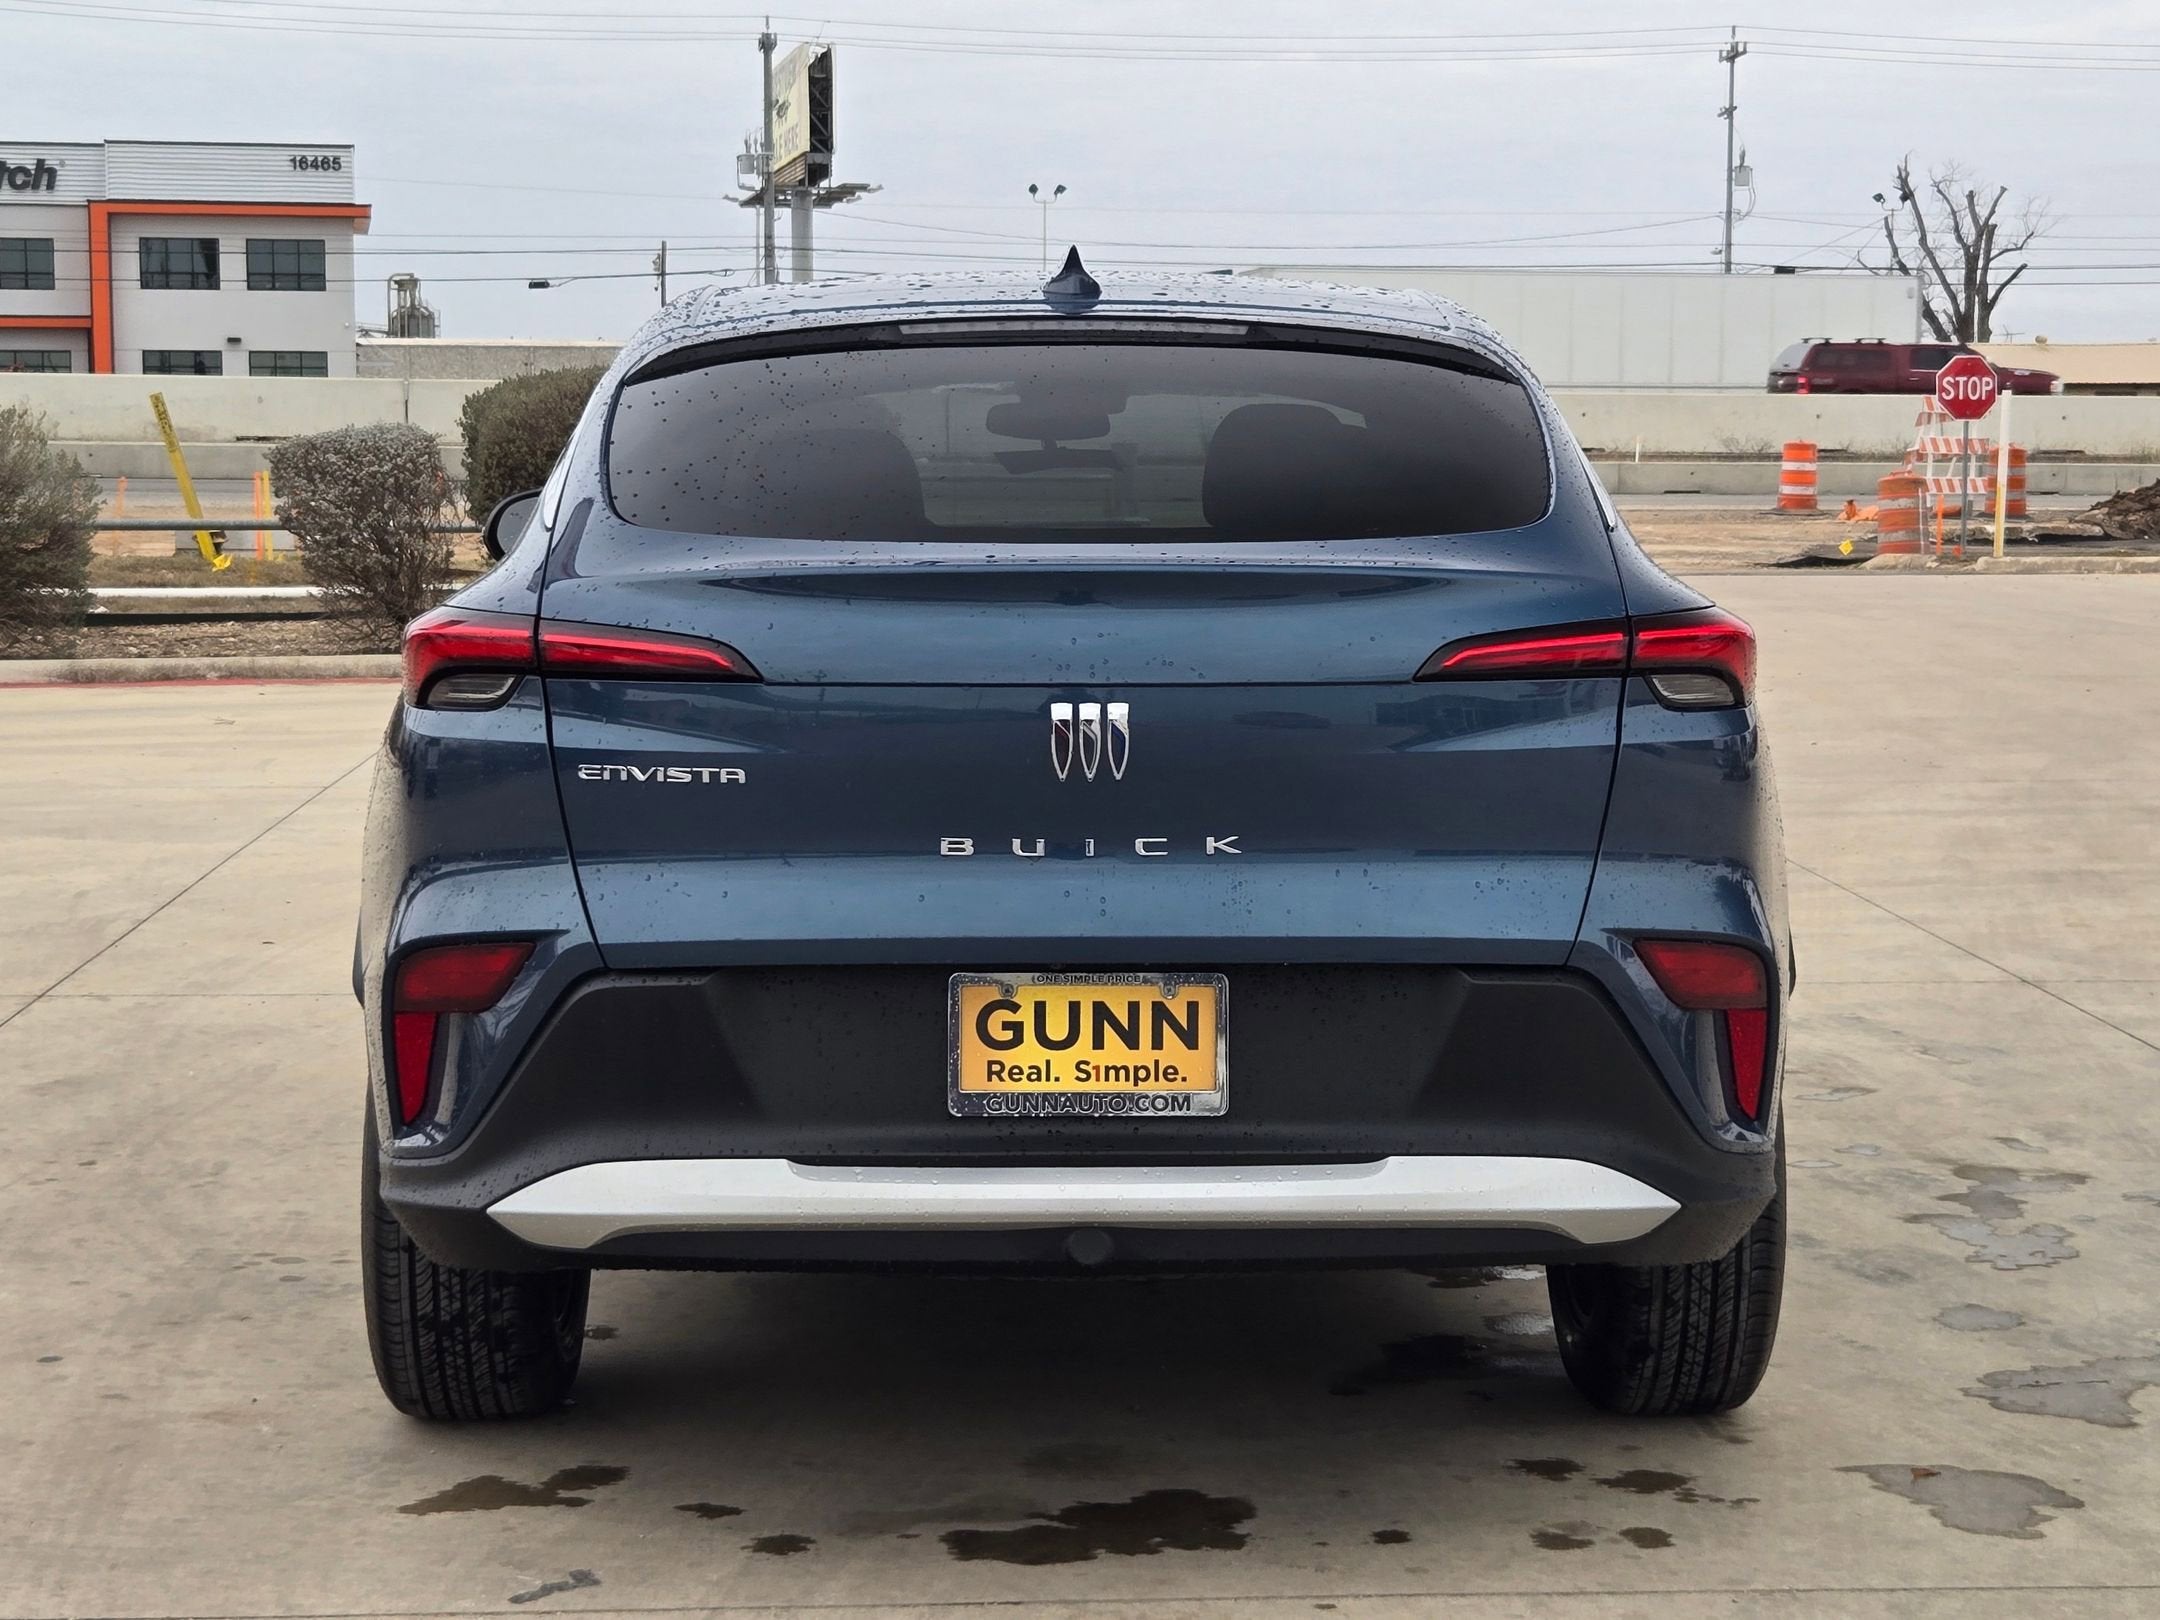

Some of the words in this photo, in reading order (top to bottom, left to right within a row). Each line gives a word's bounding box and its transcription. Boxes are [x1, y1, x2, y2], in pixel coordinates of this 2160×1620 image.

[289, 155, 342, 171] 16465
[1941, 376, 1993, 400] STOP
[578, 764, 746, 784] ENVISTA
[939, 836, 1243, 858] BUICK
[1036, 974, 1060, 984] ONE
[1063, 974, 1105, 984] SIMPLE
[1107, 974, 1142, 984] PRICE
[975, 998, 1200, 1052] GUNN
[986, 1059, 1061, 1083] Real.
[985, 1093, 1192, 1114] GUNNAUTO.COM
